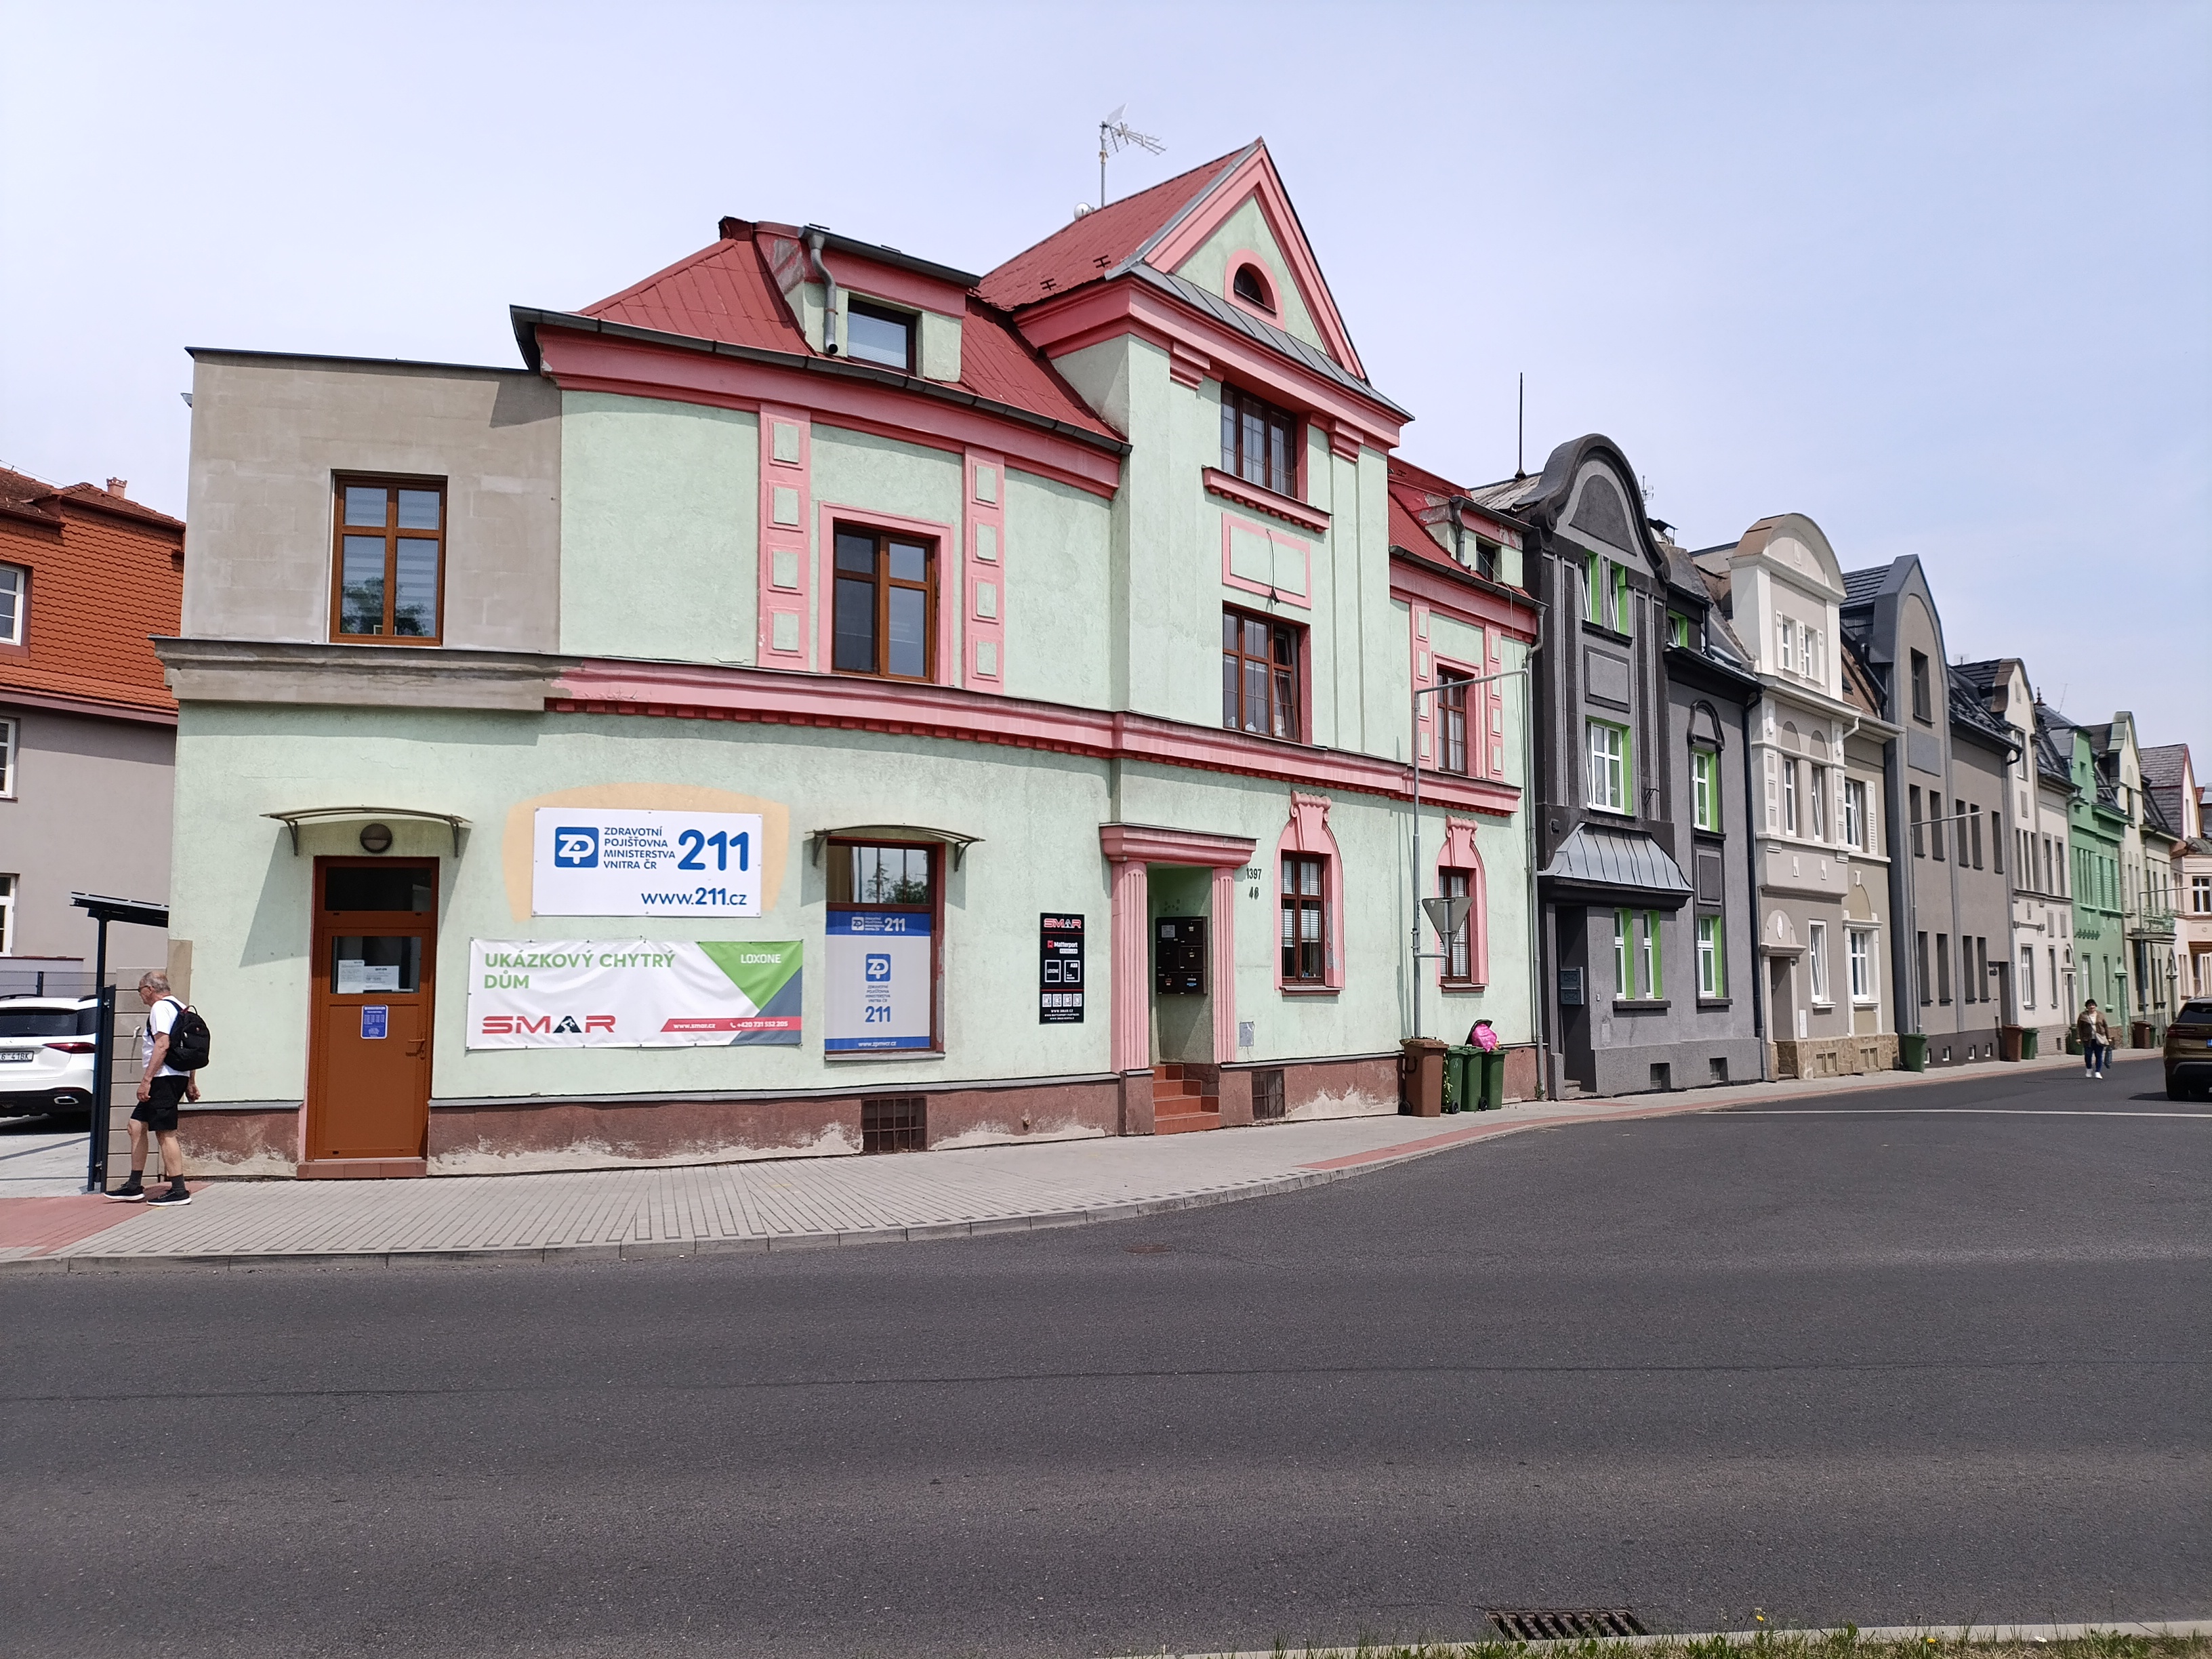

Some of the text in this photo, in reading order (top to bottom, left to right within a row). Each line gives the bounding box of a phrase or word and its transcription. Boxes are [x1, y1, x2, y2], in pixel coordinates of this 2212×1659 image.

[604, 825, 663, 836] ZDRAVOTNÍ
[604, 836, 668, 847] POJIŠŤOVNA
[604, 849, 676, 859] MINISTERSTVA
[678, 829, 749, 872] 211
[604, 859, 657, 869] VNITRA ČR
[1246, 867, 1262, 880] 1397
[641, 887, 747, 905] www.211.cz
[884, 917, 905, 932] 211
[1044, 918, 1082, 928] SMAR
[485, 949, 676, 968] UKÁZKOVÝ CHYTRÝ
[740, 953, 782, 964] LOXONE
[484, 969, 529, 989] DŮM
[865, 1006, 890, 1023] 211
[482, 1015, 616, 1034] SMAR
